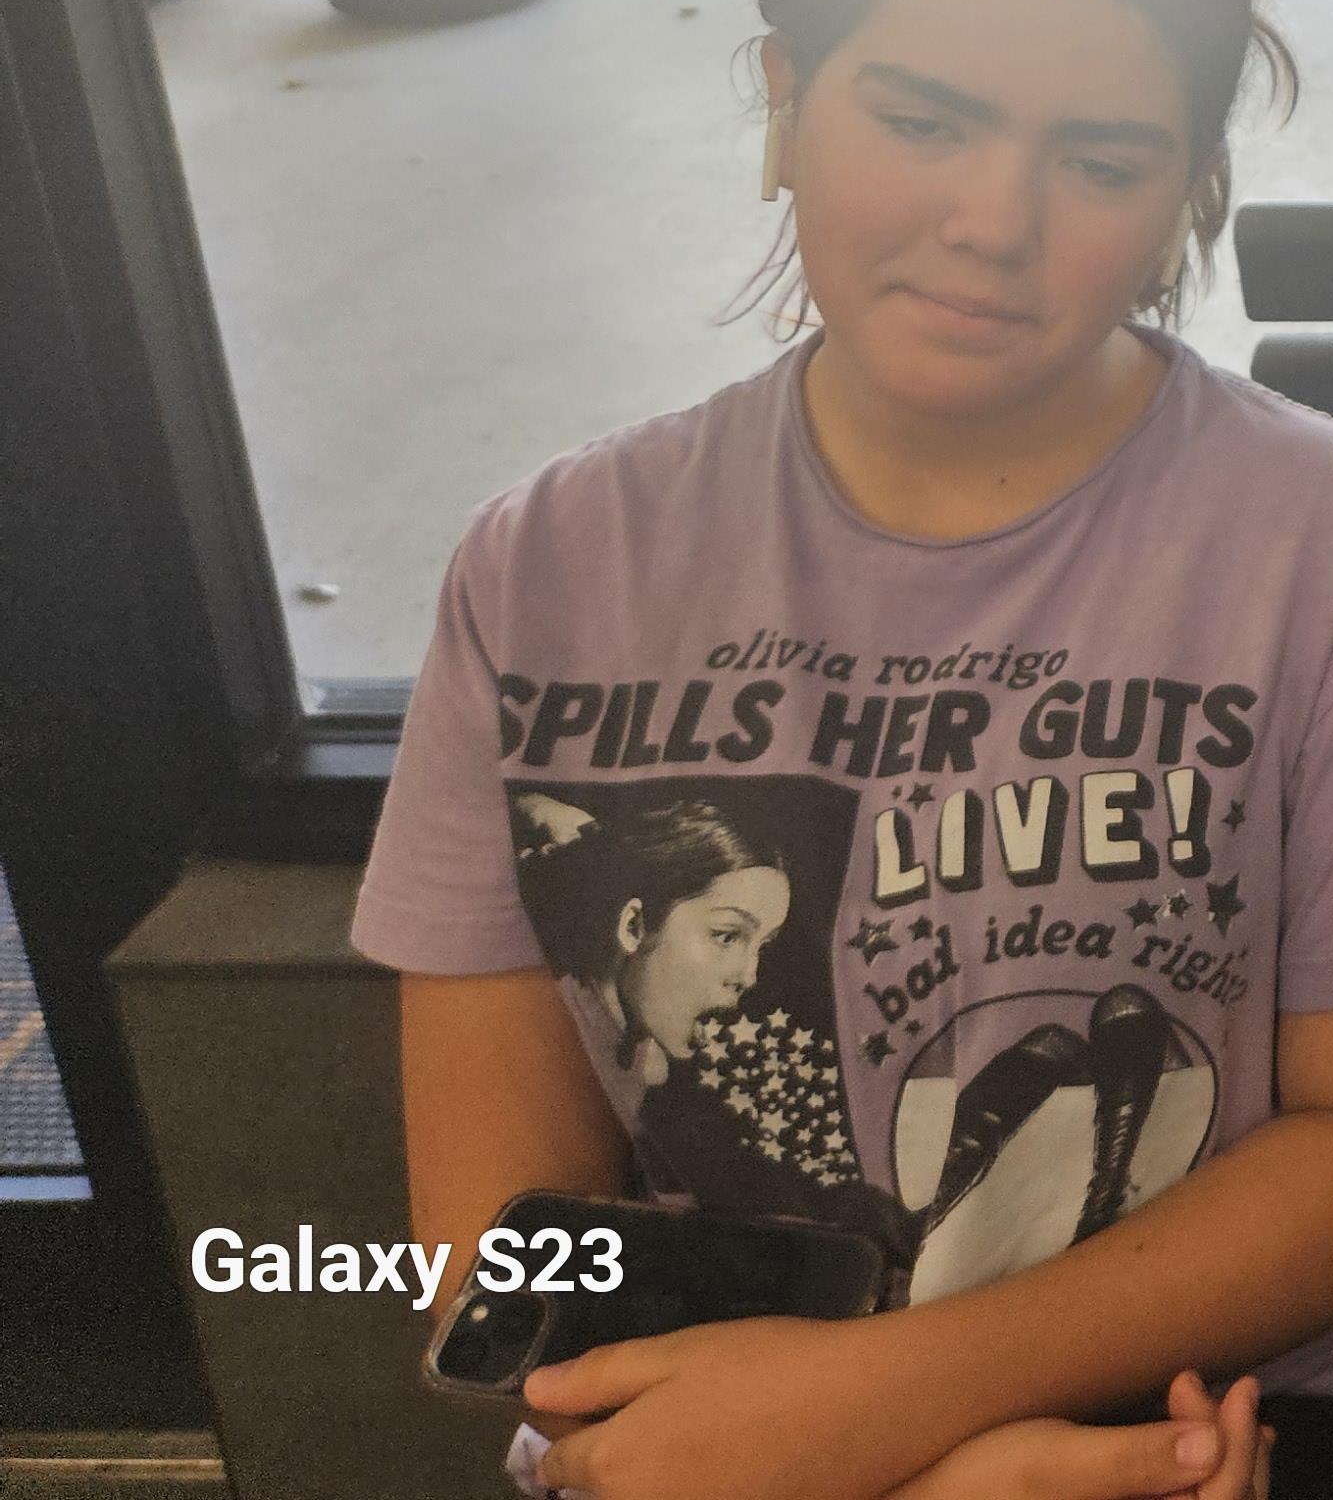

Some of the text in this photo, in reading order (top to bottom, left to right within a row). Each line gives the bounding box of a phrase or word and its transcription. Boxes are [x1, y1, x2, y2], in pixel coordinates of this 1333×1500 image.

[705, 627, 1070, 690] olivia rodrigo
[499, 672, 1259, 779] SPILLS HER GUTS
[873, 766, 1213, 904] LIVE!
[865, 923, 962, 1023] bad
[984, 904, 1117, 963] idea
